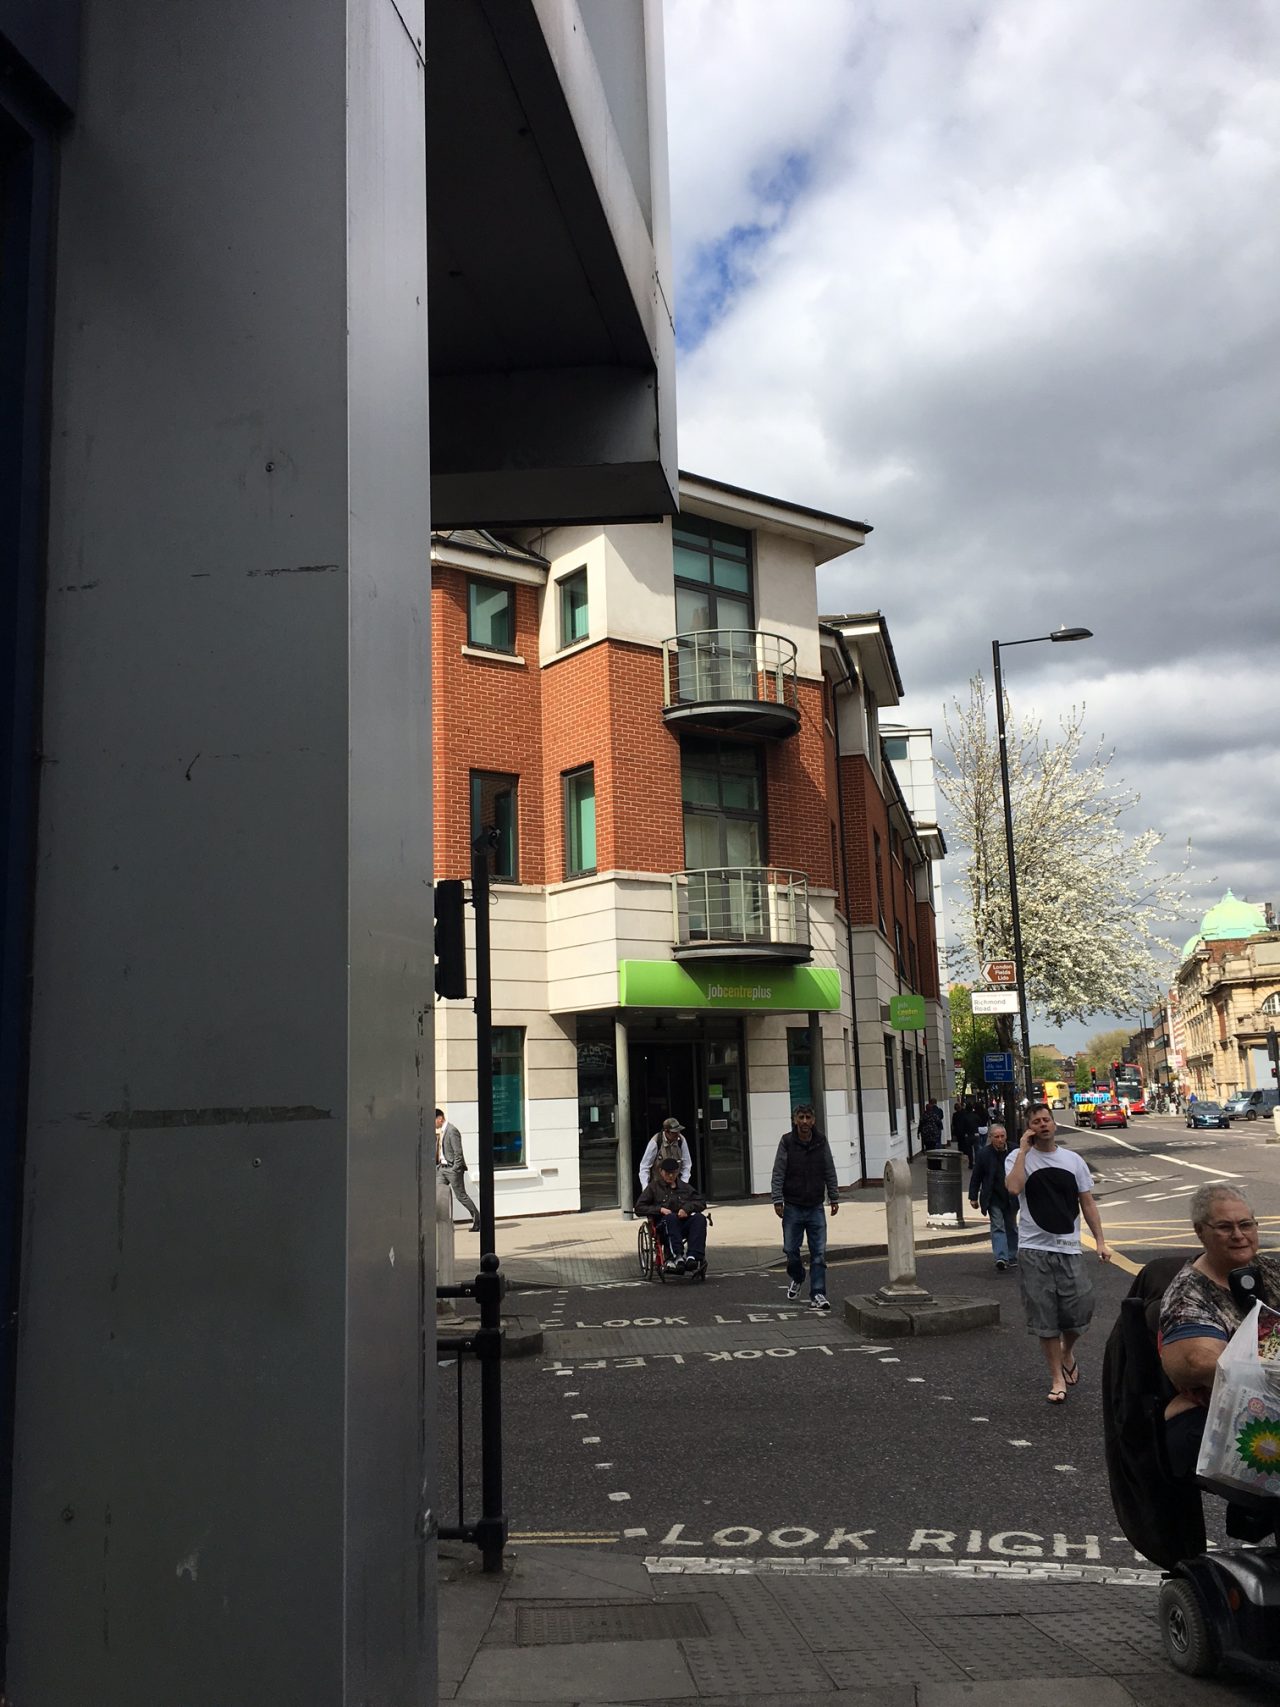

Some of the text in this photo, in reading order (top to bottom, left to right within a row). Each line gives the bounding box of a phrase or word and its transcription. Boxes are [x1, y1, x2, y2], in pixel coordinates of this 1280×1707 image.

[708, 984, 772, 1001] jobcentreplus
[576, 1310, 832, 1329] LOOK LEFT
[542, 1345, 833, 1372] LOOK LEFT
[659, 1523, 876, 1551] LOOK
